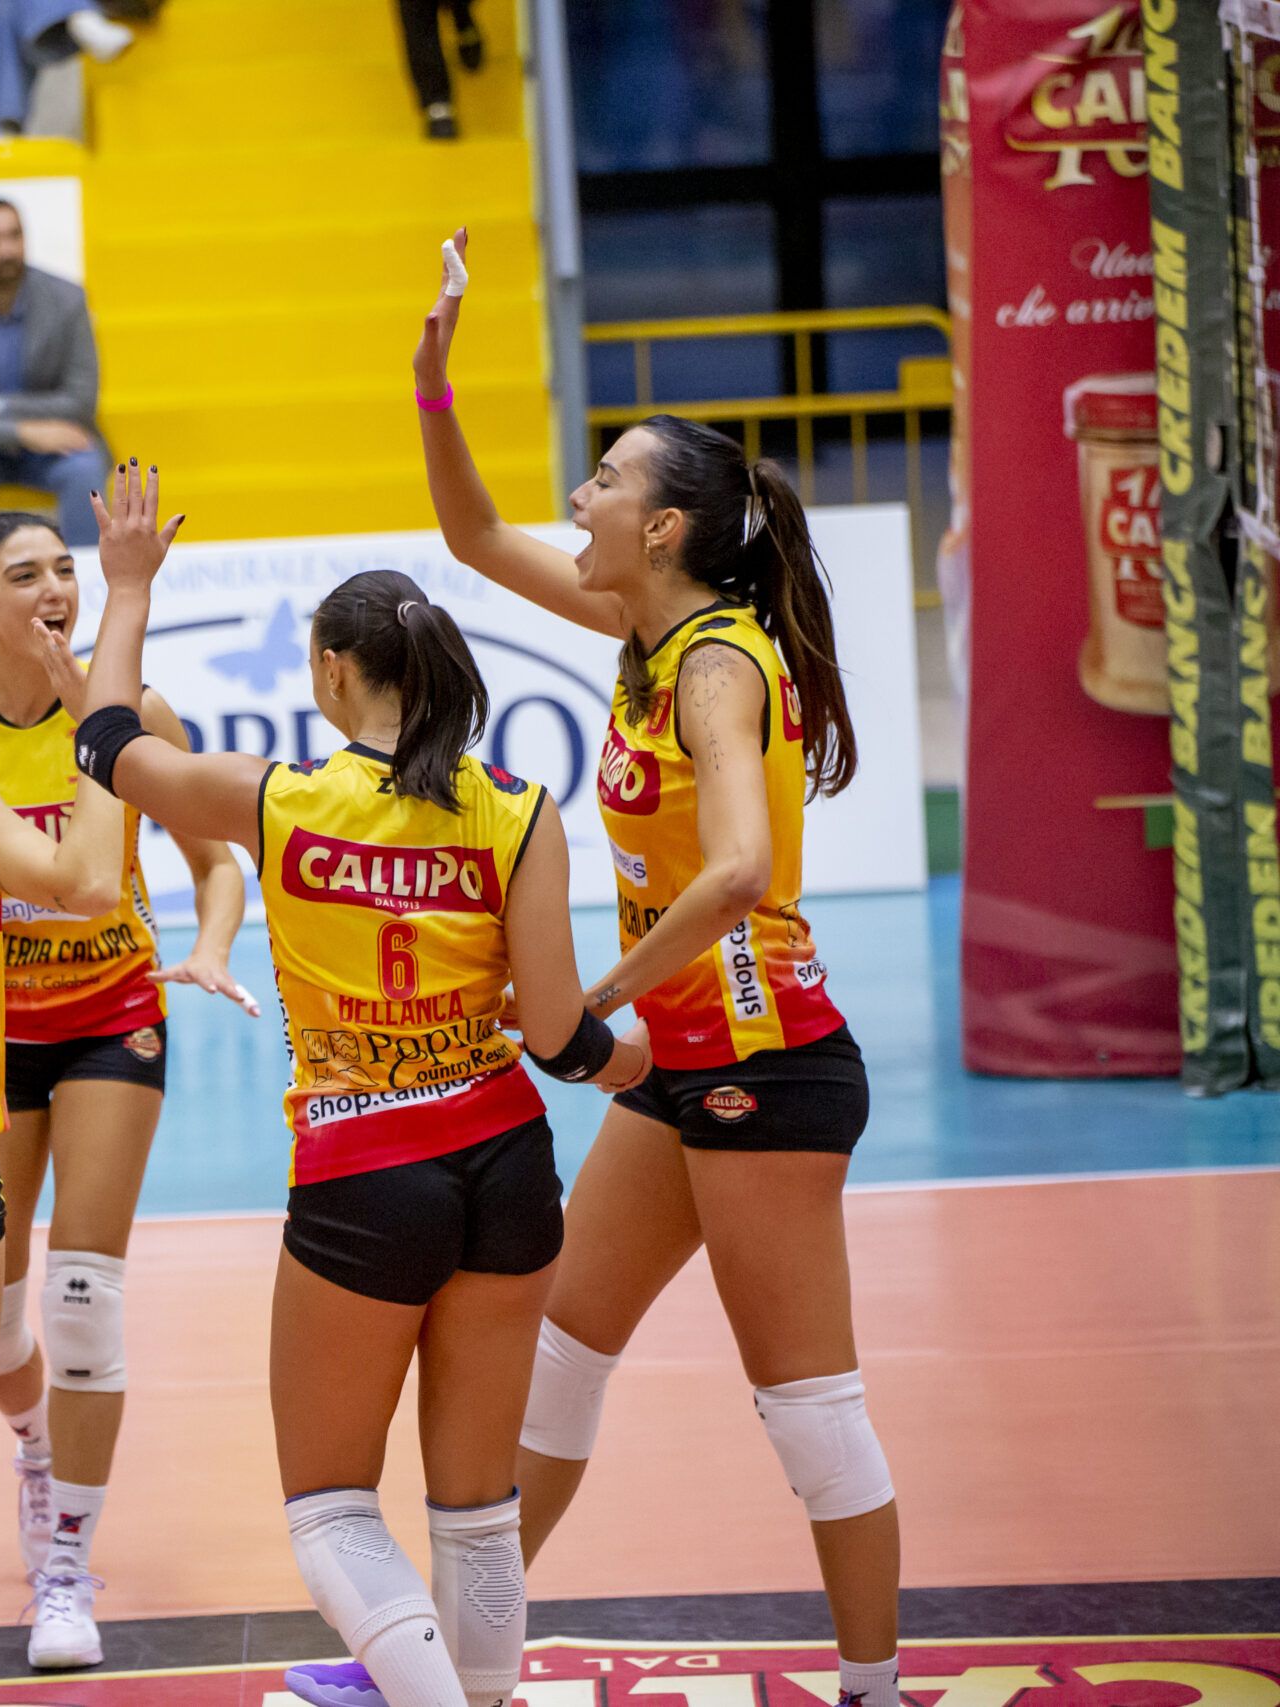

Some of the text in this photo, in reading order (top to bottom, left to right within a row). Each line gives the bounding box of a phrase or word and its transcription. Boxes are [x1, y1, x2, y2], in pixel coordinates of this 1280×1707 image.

[1151, 217, 1194, 494] CREDEM
[299, 845, 484, 901] CALLIPO
[375, 897, 421, 911] DAL 1913
[58, 923, 140, 964] CALLIPO
[378, 919, 419, 1001] 6
[338, 989, 464, 1026] BELLANCA
[706, 1095, 753, 1108] CALLIPO
[583, 1655, 720, 1674] DAL
